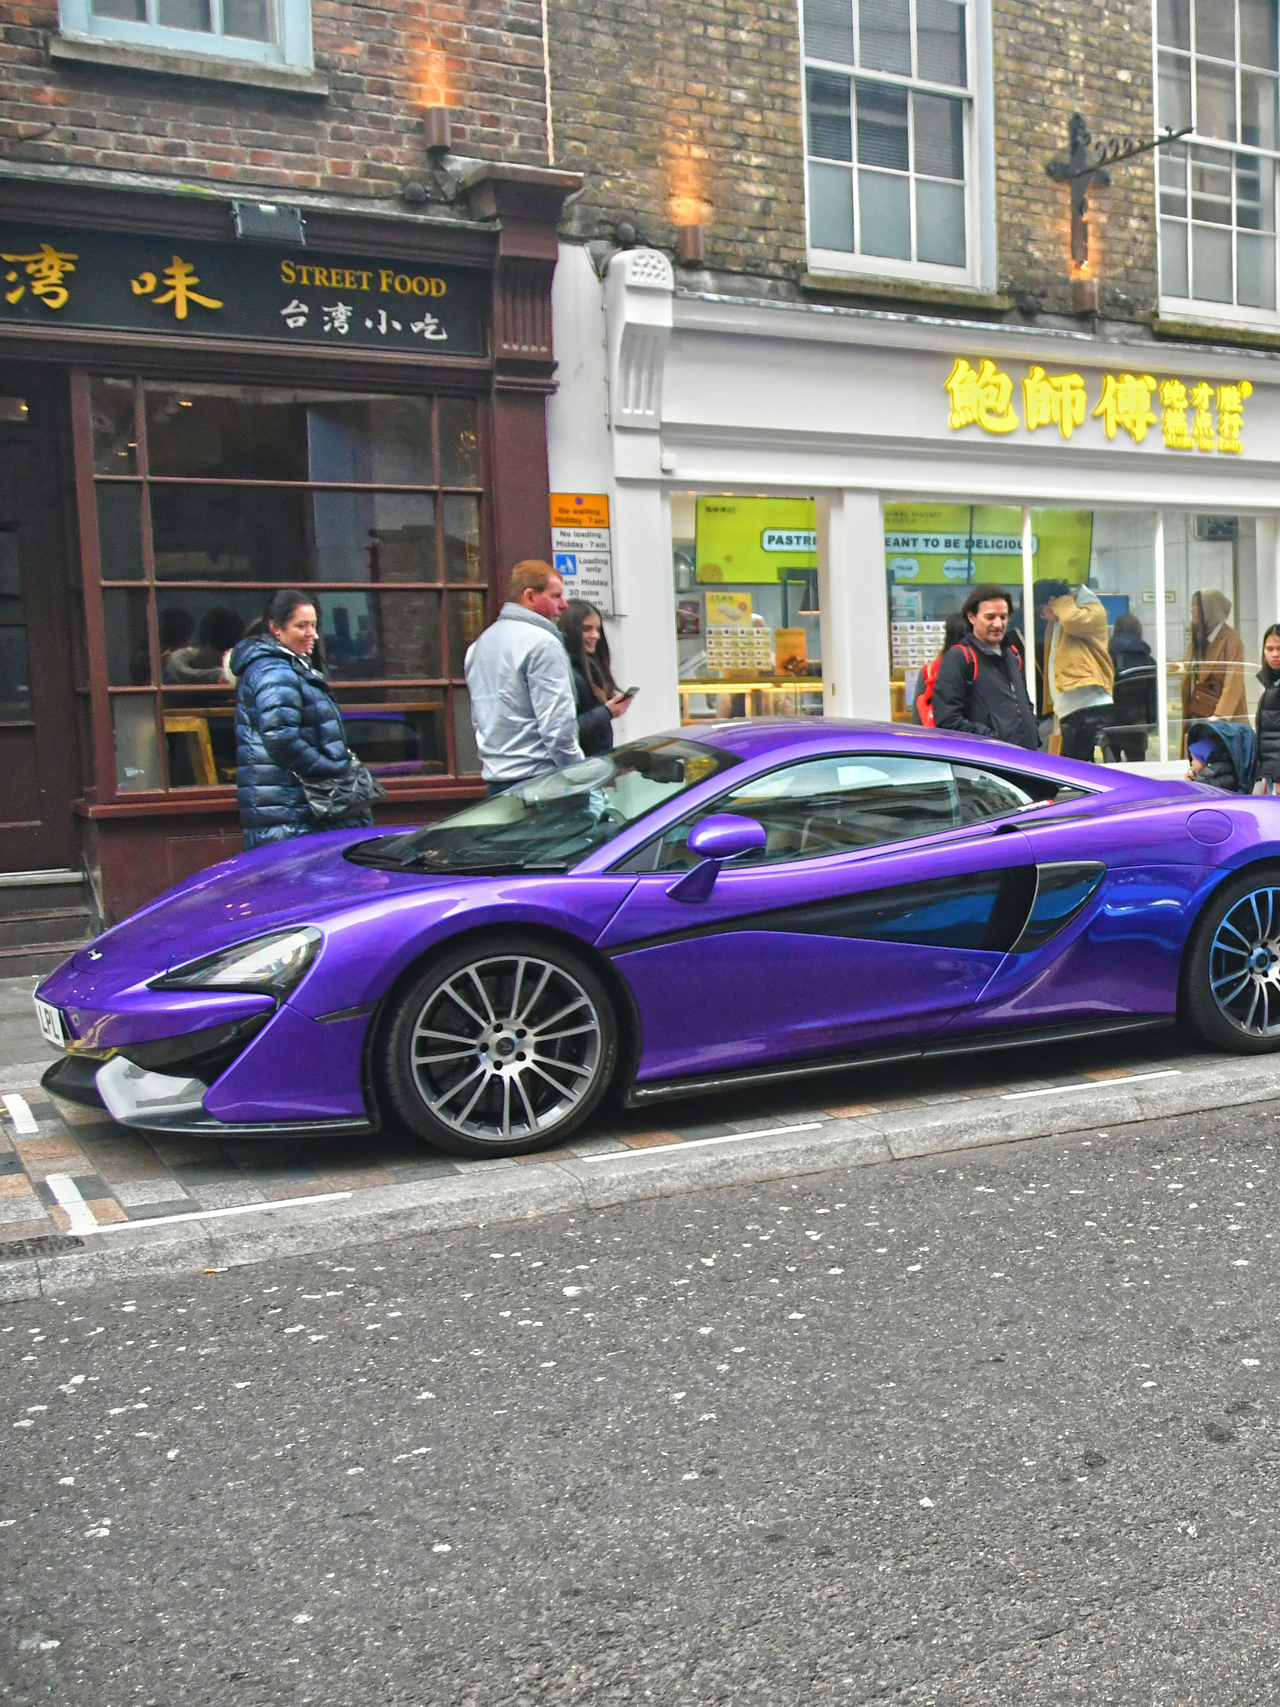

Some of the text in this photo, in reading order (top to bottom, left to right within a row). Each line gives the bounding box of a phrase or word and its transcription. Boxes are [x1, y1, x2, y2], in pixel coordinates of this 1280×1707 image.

[281, 260, 447, 297] STREET FOOD
[280, 299, 449, 341] 台湾小吃
[1198, 436, 1215, 450] Bao
[1216, 437, 1244, 454] Pastry
[573, 507, 600, 516] waiting
[554, 516, 582, 525] Midday
[560, 530, 601, 540] No loading
[556, 541, 583, 550] Midday
[589, 541, 595, 549] 7
[767, 535, 816, 546] PASTRI
[924, 538, 940, 549] TO
[944, 538, 960, 549] BE
[579, 557, 608, 566] Loading
[581, 579, 609, 588] Midday
[568, 588, 599, 597] 30 mins
